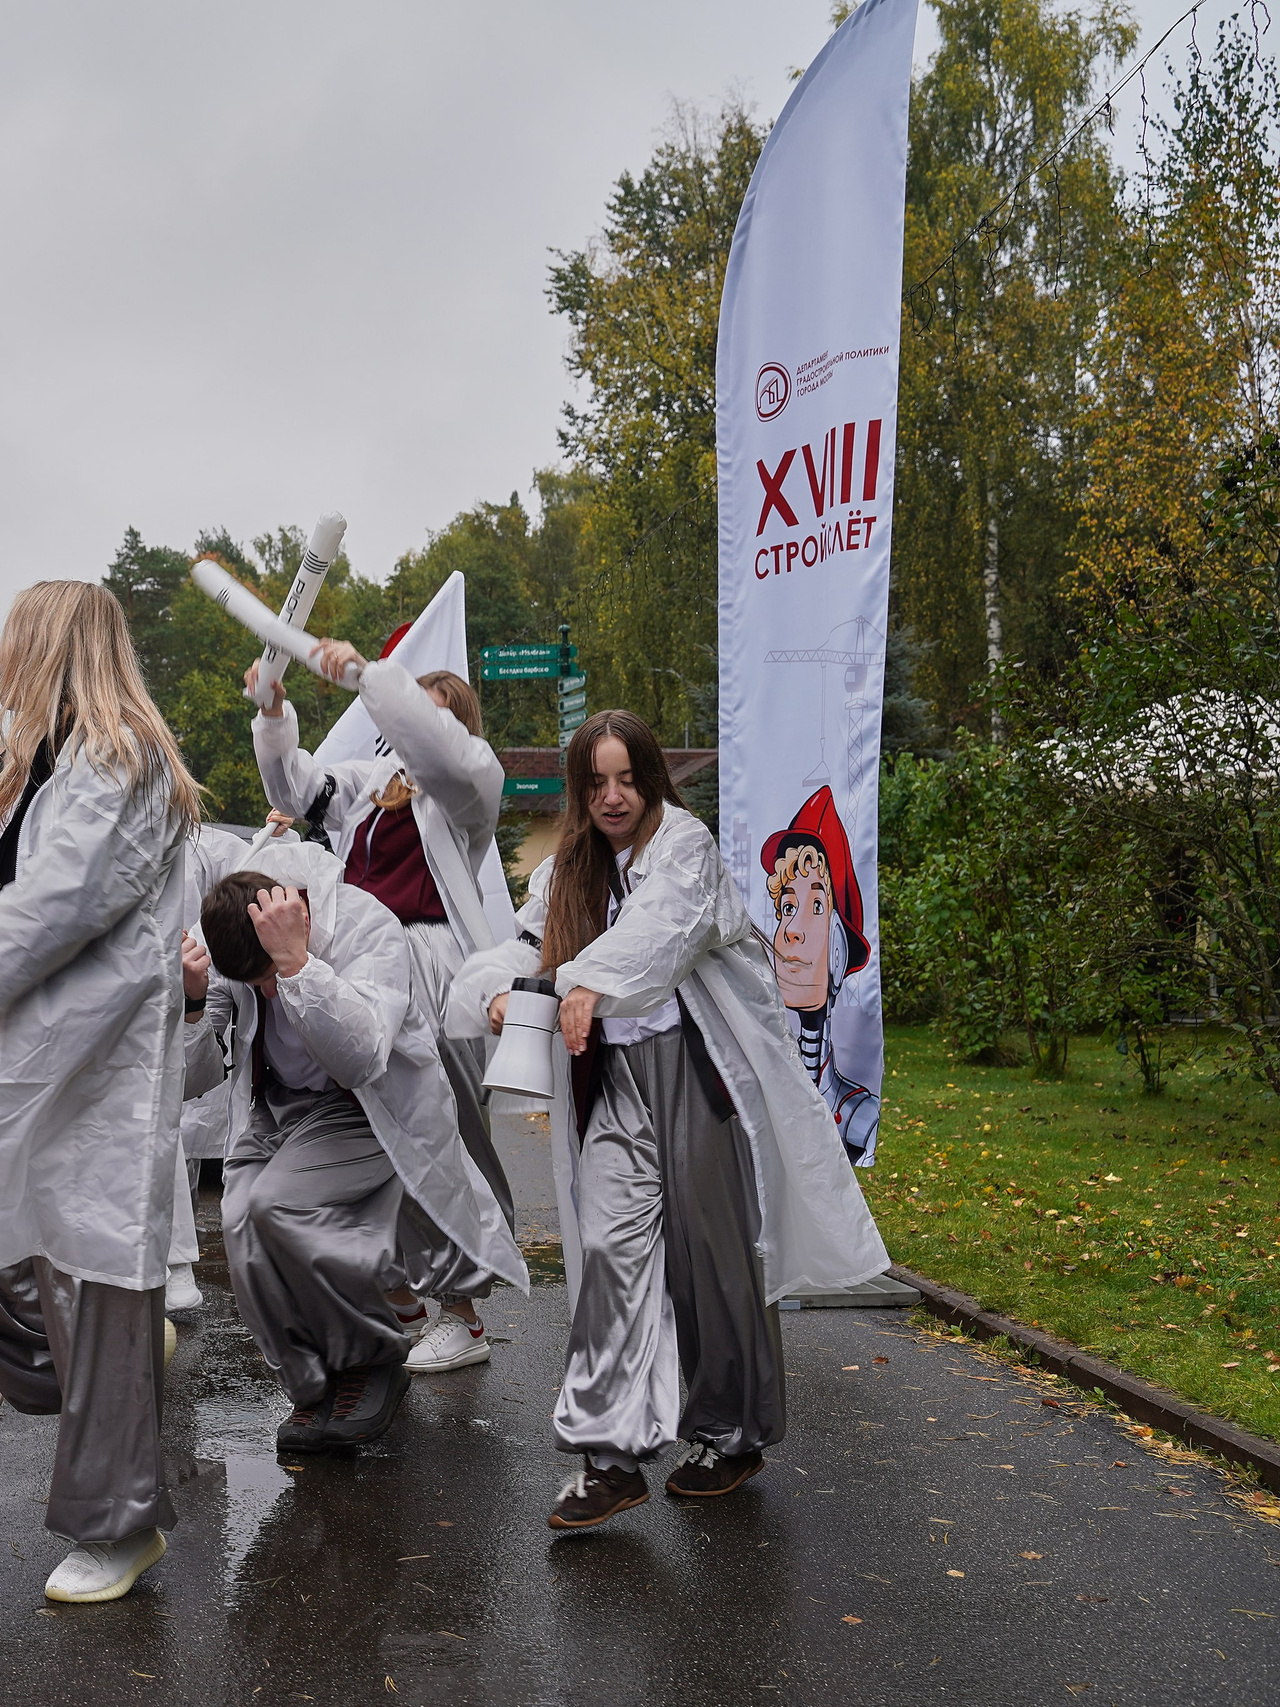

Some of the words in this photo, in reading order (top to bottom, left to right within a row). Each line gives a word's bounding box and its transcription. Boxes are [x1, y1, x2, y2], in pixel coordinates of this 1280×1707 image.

[845, 345, 890, 361] ПОЛИТИКИ
[796, 381, 820, 398] ГОРОДА
[756, 419, 882, 537] XVIII
[754, 509, 877, 580] СТРОЙСЛЁТ
[515, 782, 539, 791] Экопарк
